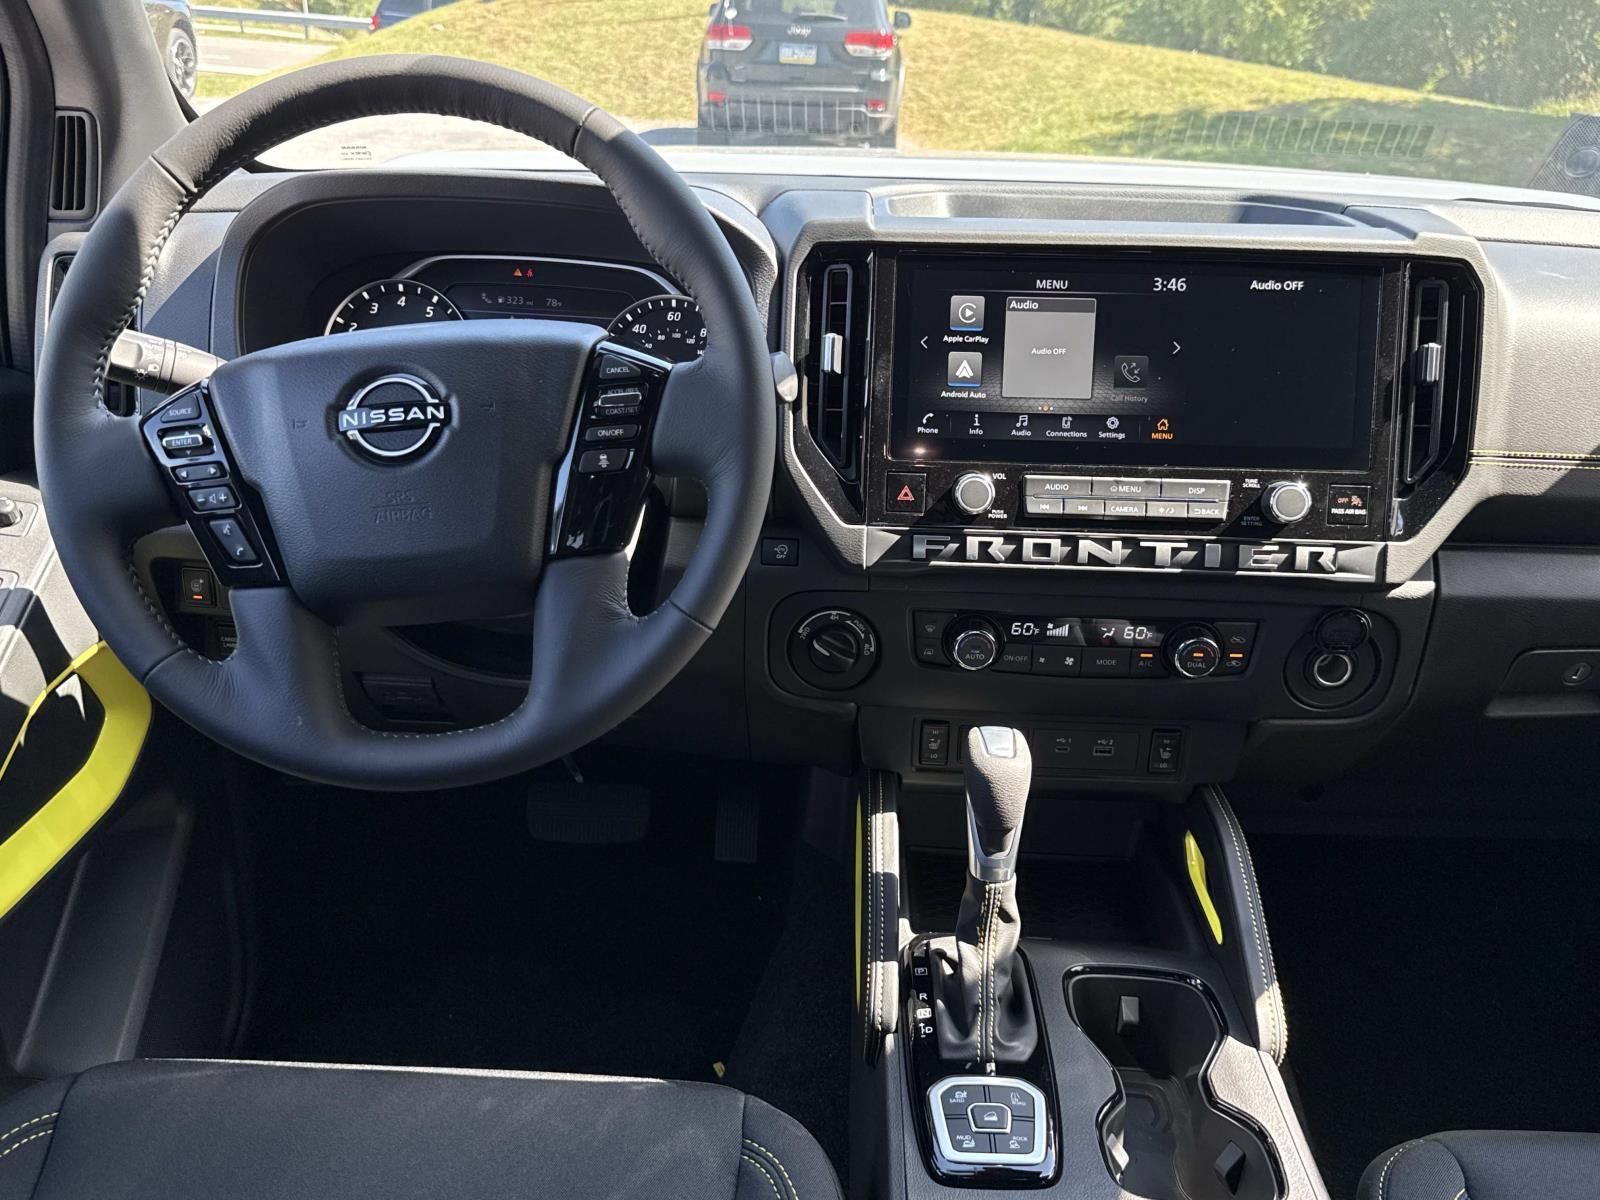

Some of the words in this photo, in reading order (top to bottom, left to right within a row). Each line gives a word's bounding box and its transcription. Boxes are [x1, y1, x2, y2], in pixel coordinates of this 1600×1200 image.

[1036, 280, 1068, 289] MENU
[1153, 278, 1187, 292] 3:46
[1250, 280, 1281, 290] Audio
[1284, 281, 1304, 290] OFF
[397, 296, 406, 307] 4
[506, 296, 523, 304] 323
[369, 302, 379, 314] 3
[1010, 301, 1038, 310] Audio
[425, 306, 434, 318] 5
[667, 311, 681, 321] 60
[632, 324, 647, 334] 40
[943, 335, 963, 344] Apple
[964, 336, 989, 345] CarPlay
[969, 391, 987, 399] Auto
[1124, 394, 1149, 404] History
[342, 405, 445, 428] NISSAN
[597, 428, 624, 436] ON/OFF
[917, 427, 939, 435] Phone
[1046, 430, 1088, 438] Connections
[1098, 431, 1126, 440] Settings
[912, 534, 1337, 572] FRONTIER
[965, 653, 985, 661] AUTO
[1187, 660, 1206, 669] DUAL
[919, 992, 928, 1000] R
[925, 1026, 933, 1034] D
